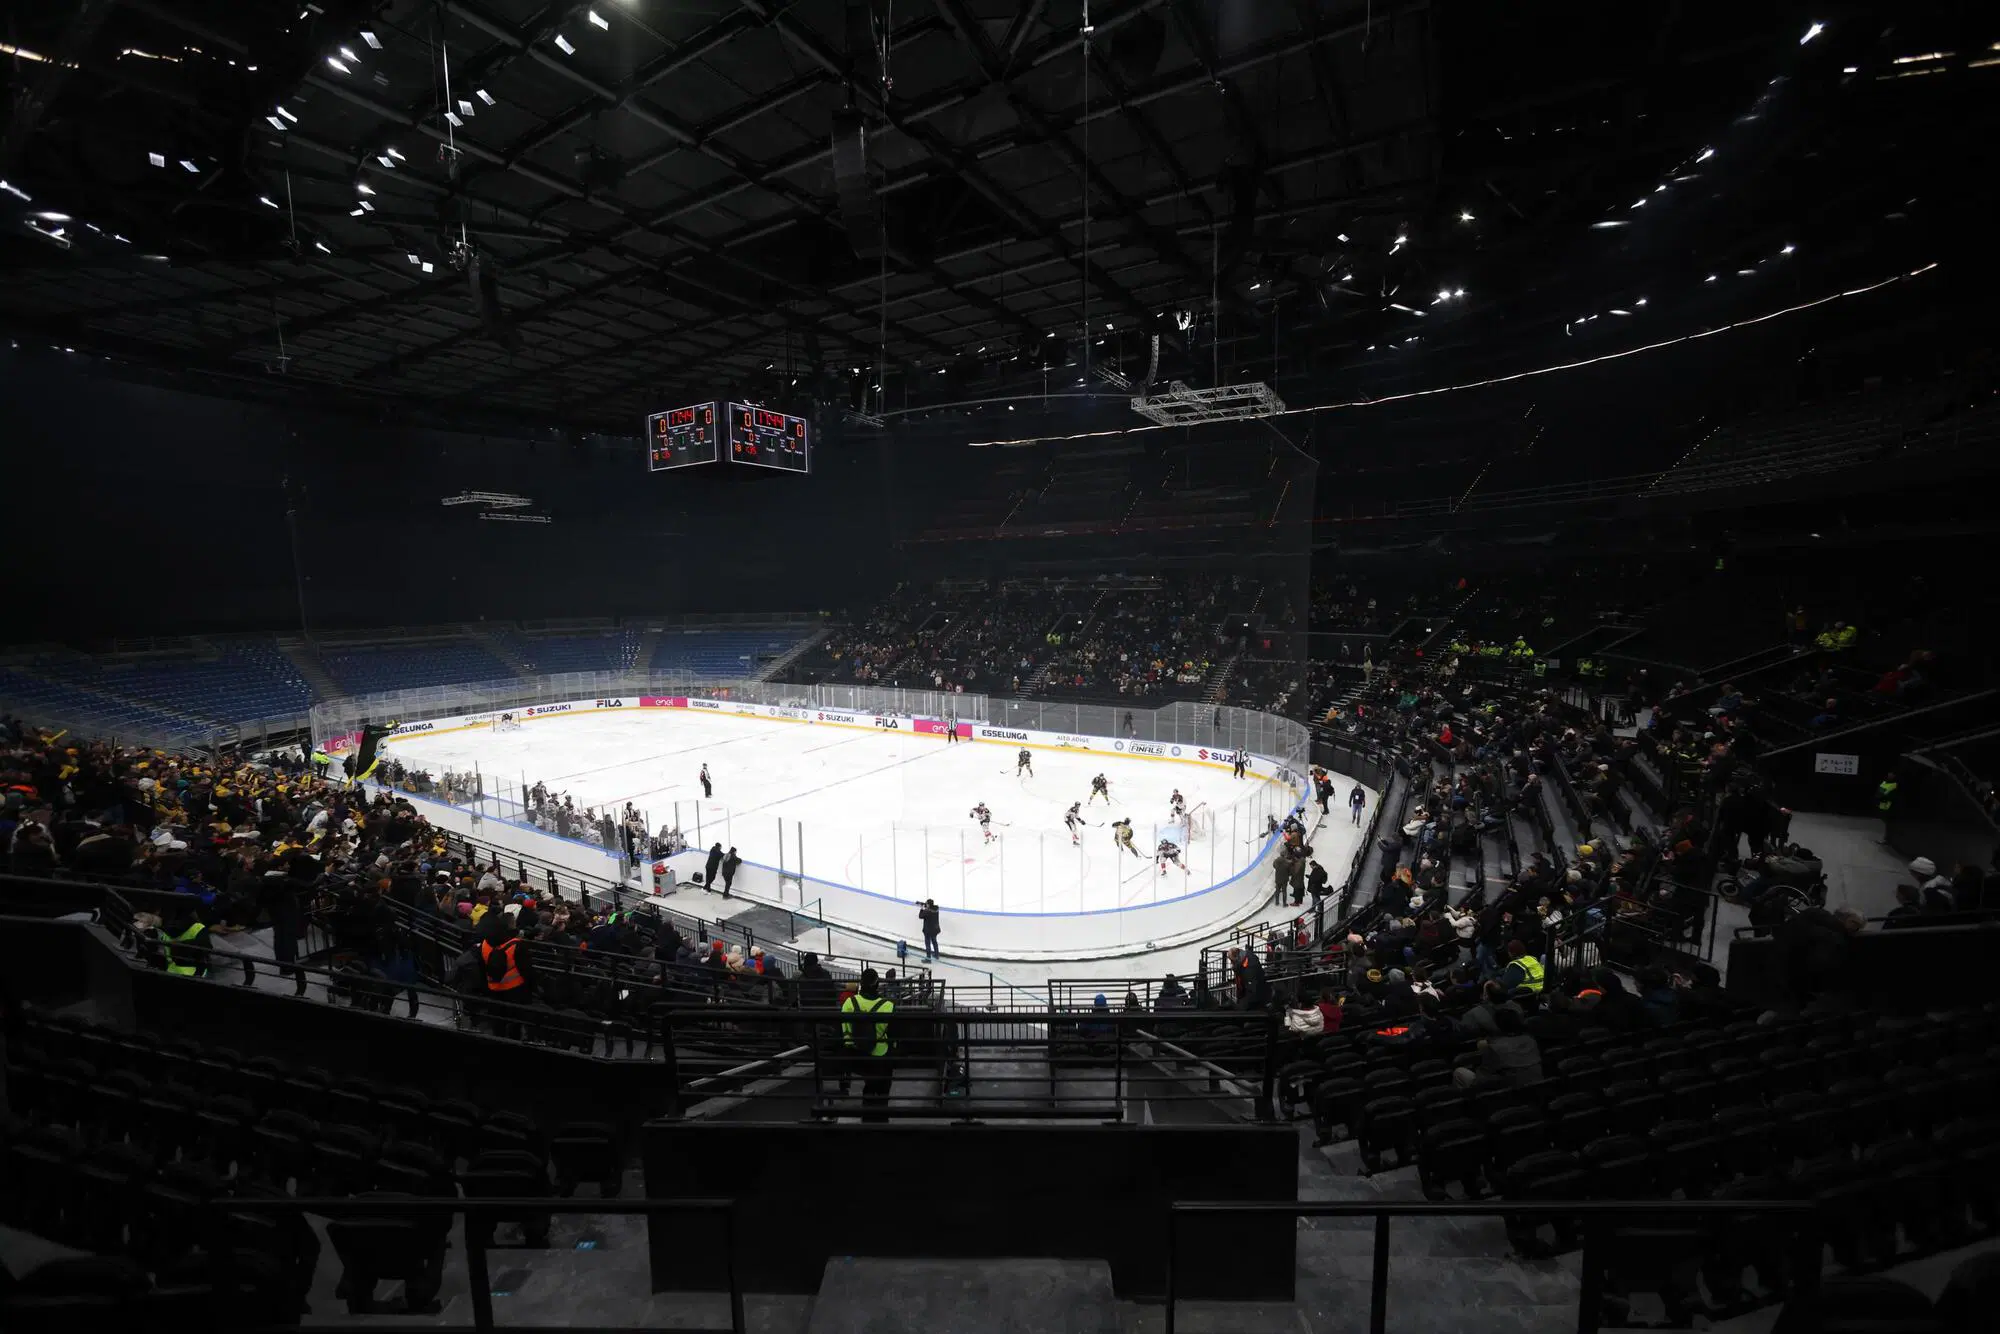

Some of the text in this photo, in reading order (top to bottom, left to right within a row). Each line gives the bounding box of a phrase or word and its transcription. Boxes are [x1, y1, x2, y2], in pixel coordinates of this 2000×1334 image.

[706, 409, 712, 424] 0
[744, 413, 751, 427] 0
[759, 411, 783, 428] 17:44
[660, 419, 666, 433] 0
[797, 424, 803, 437] 0
[537, 704, 571, 714] SUZUKI
[596, 699, 622, 708] FILA
[826, 714, 854, 723] SUZUKI
[876, 717, 898, 729] FILA
[932, 725, 950, 734] ene
[982, 729, 1027, 741] ESSELUNGA
[1131, 745, 1163, 754] FINALS
